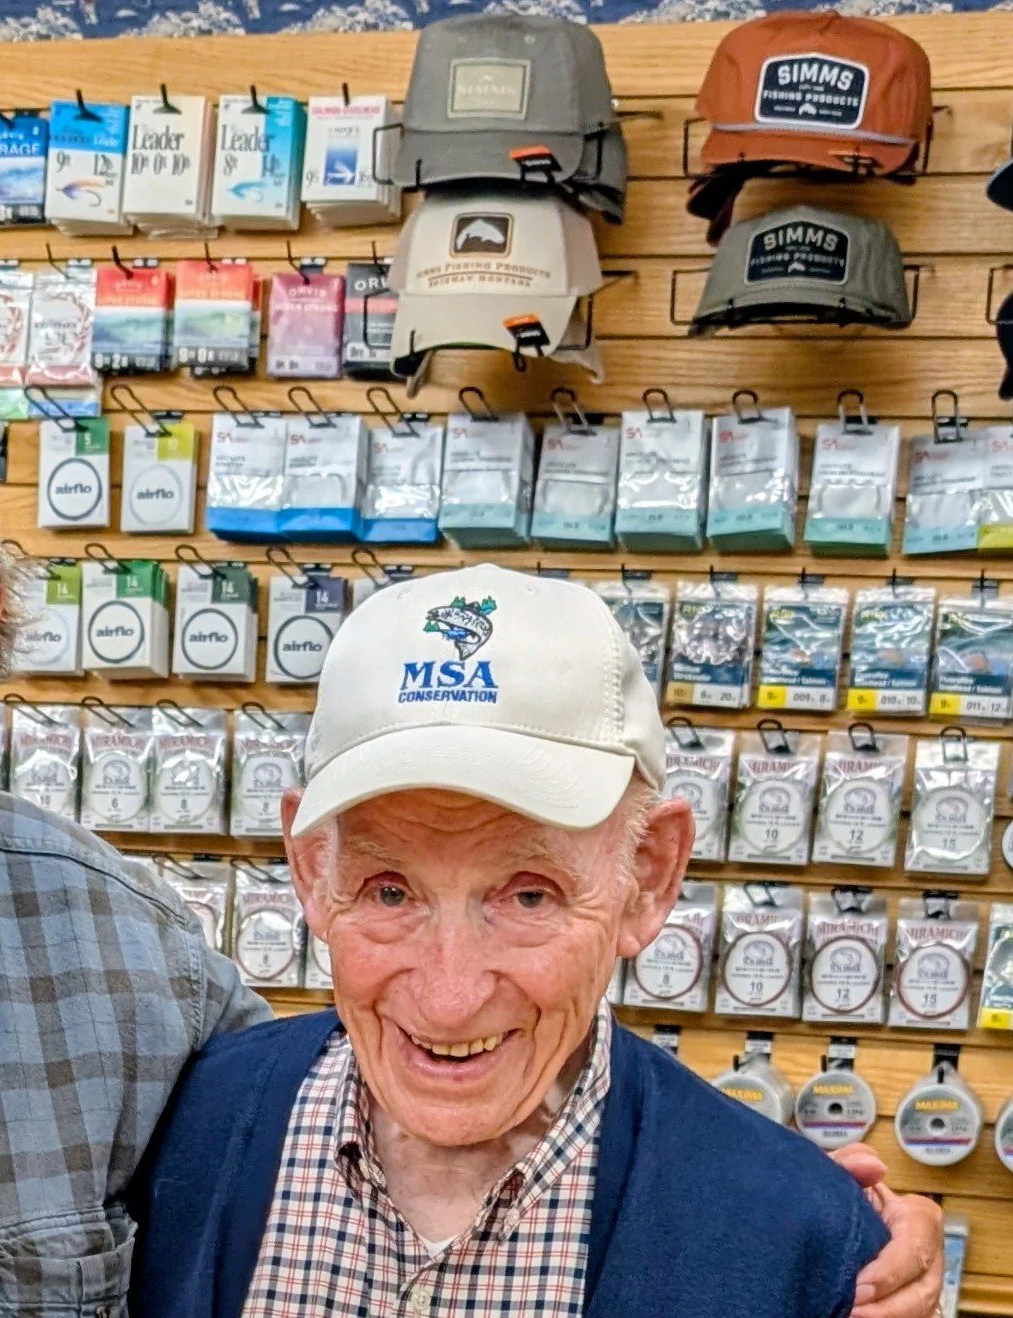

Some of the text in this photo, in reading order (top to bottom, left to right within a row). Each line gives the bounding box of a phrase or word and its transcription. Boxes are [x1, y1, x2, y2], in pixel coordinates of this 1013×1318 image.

[777, 62, 854, 91] SIMMS
[763, 90, 859, 107] FISHING PRODUCTS
[132, 125, 185, 151] Leader
[221, 124, 275, 152] Leader
[763, 226, 838, 252] SIMMS
[55, 482, 93, 496] airflo
[137, 488, 175, 501] airflo
[95, 625, 134, 638] airflo
[188, 630, 229, 643] airflo
[281, 640, 323, 652] airflo
[399, 660, 499, 691] MSA
[397, 689, 498, 704] CONSERVATION
[765, 828, 779, 840] 10
[849, 830, 864, 842] 12
[749, 981, 763, 993] 10
[836, 987, 850, 1000] 12
[923, 992, 937, 1005] 15
[813, 1084, 854, 1096] MAXIMA
[915, 1100, 959, 1111] MAXIMA
